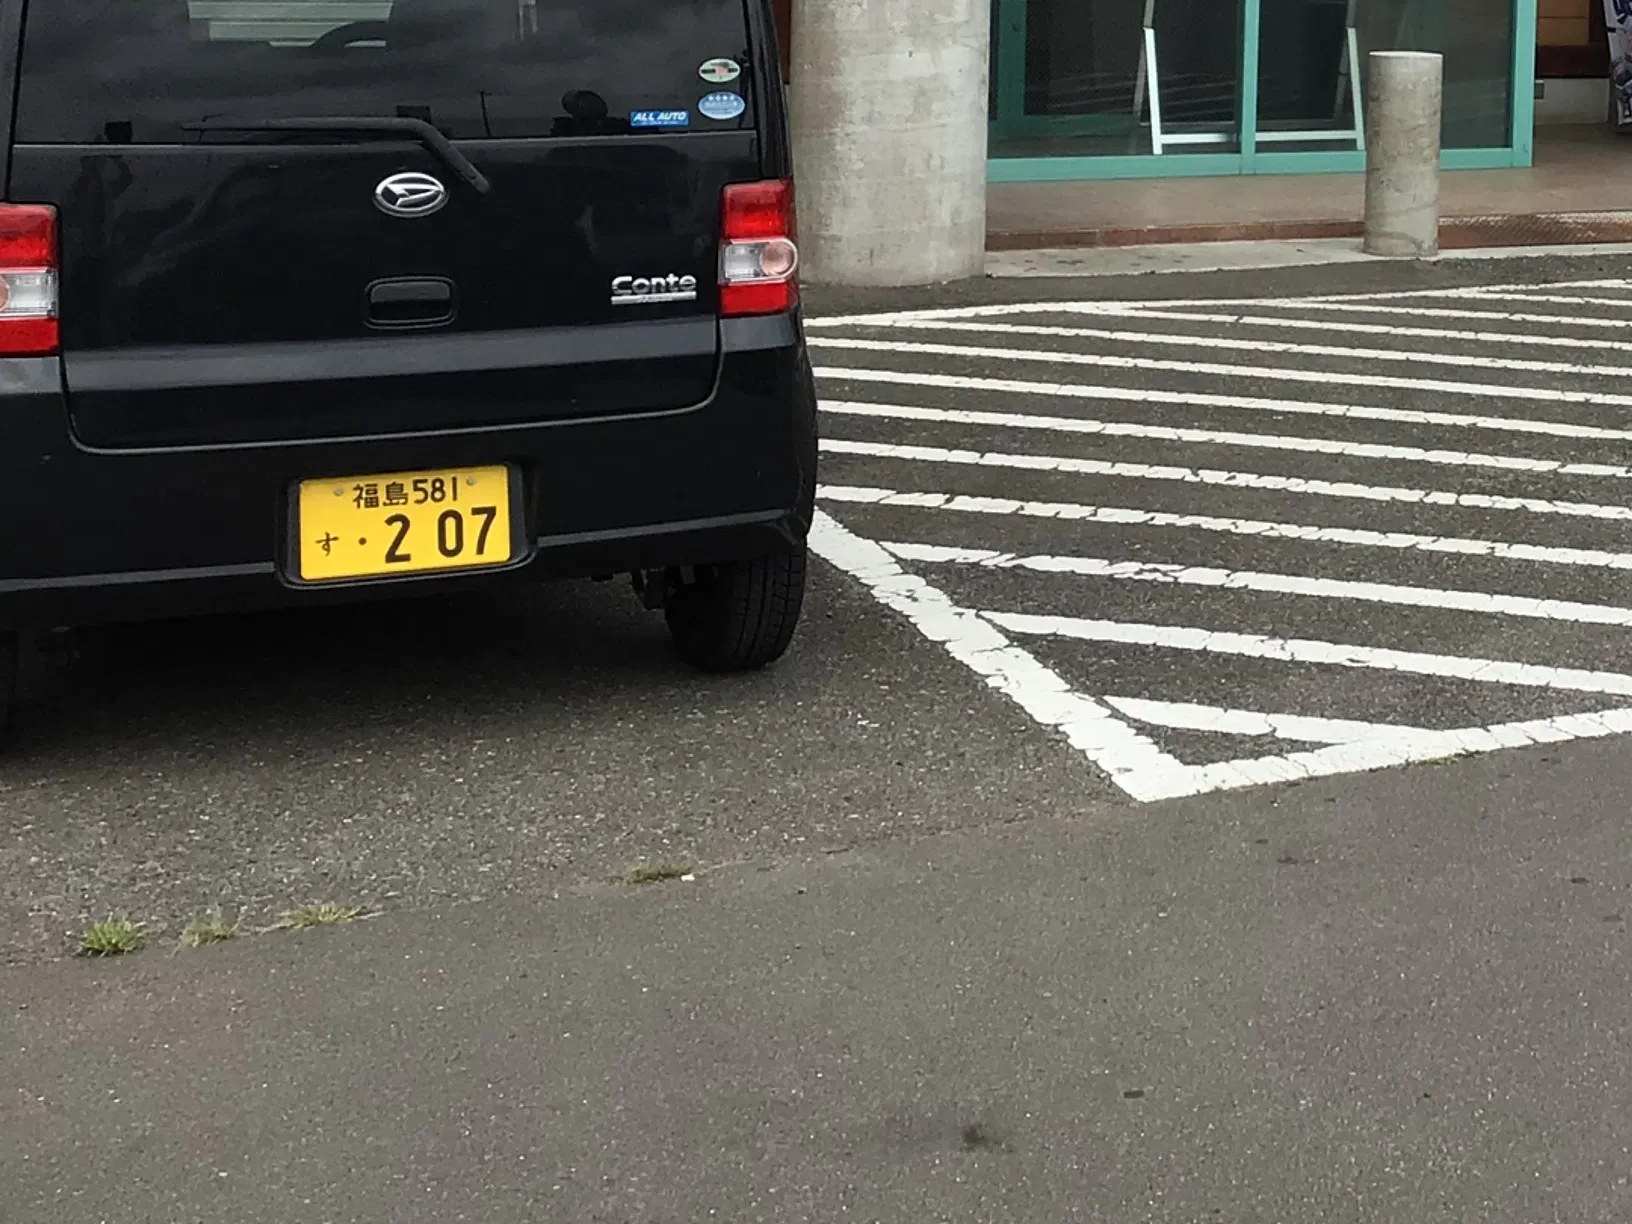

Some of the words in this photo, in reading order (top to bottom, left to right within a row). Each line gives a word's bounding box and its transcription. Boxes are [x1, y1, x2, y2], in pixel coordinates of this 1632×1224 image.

[633, 112, 655, 122] ALL
[657, 111, 687, 121] AUTO
[612, 273, 697, 295] Conte
